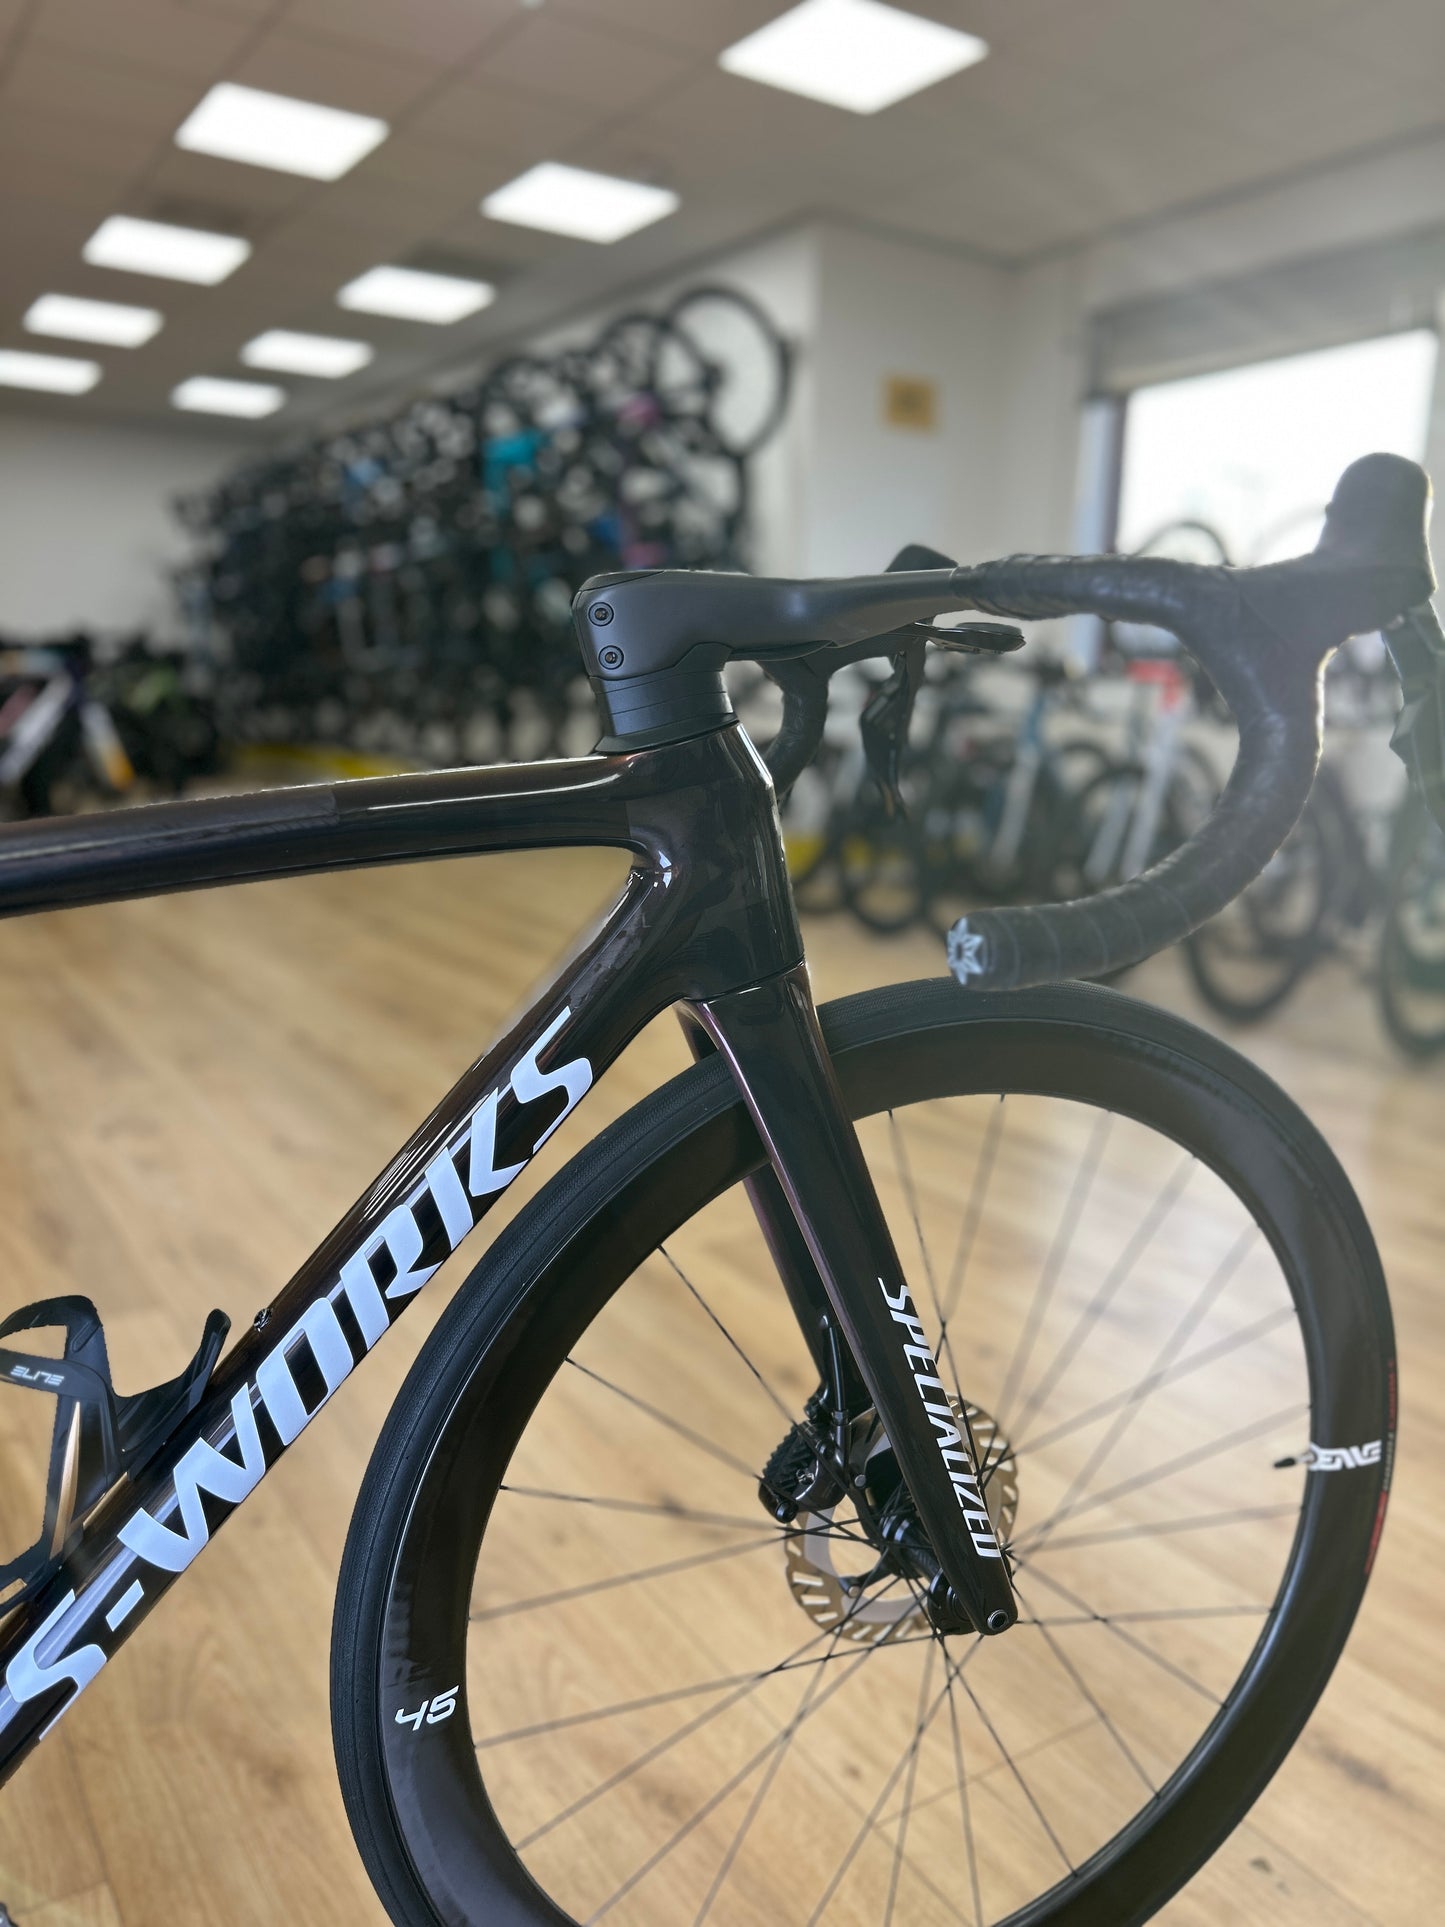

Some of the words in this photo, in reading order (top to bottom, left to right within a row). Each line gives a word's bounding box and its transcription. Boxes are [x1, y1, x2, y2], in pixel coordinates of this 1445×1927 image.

[5, 1006, 593, 1741] S-WORKS
[877, 1276, 1001, 1558] SPECIALIZED
[394, 1685, 459, 1731] 45
